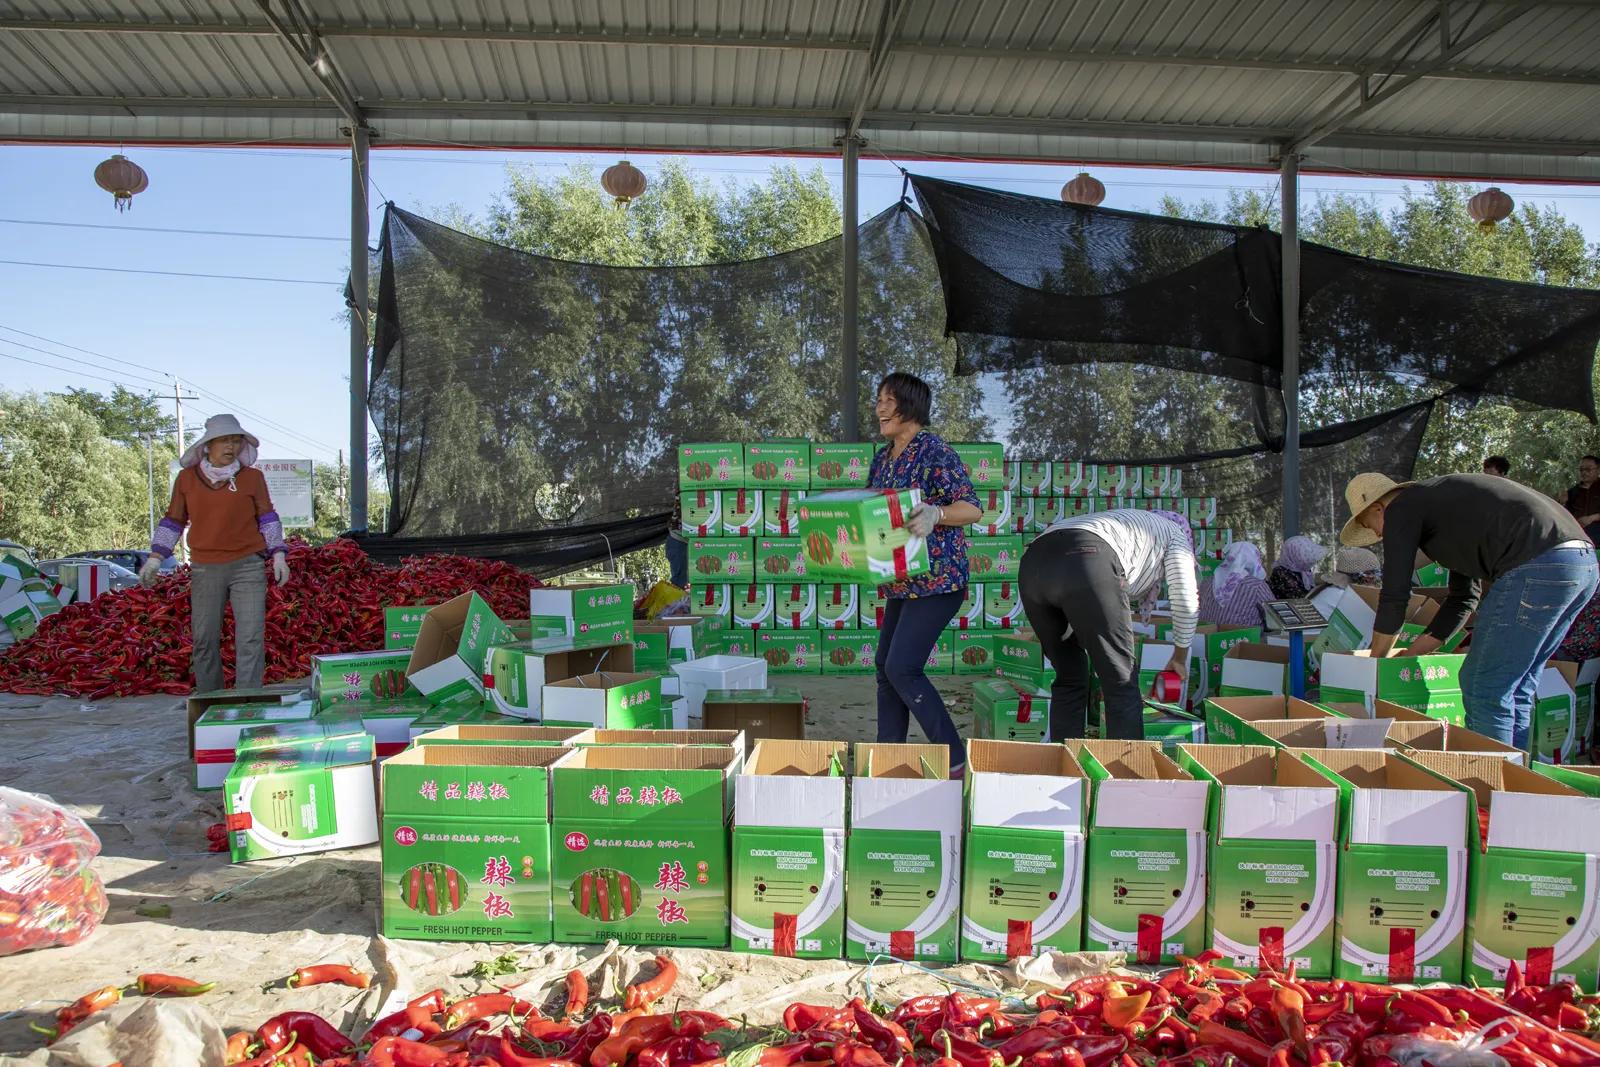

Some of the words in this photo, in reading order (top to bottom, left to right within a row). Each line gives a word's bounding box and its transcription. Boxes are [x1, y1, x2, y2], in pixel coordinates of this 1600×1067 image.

[419, 780, 509, 802] 精品辣椒
[589, 785, 683, 806] 精品辣椒
[480, 855, 515, 921] 辣椒
[653, 860, 690, 927] 辣椒
[423, 925, 450, 935] FRESH
[452, 926, 469, 935] HOT
[471, 927, 502, 936] PEPPER
[595, 930, 623, 940] FRESH
[625, 931, 642, 941] HOT
[645, 932, 677, 942] PEPPER
